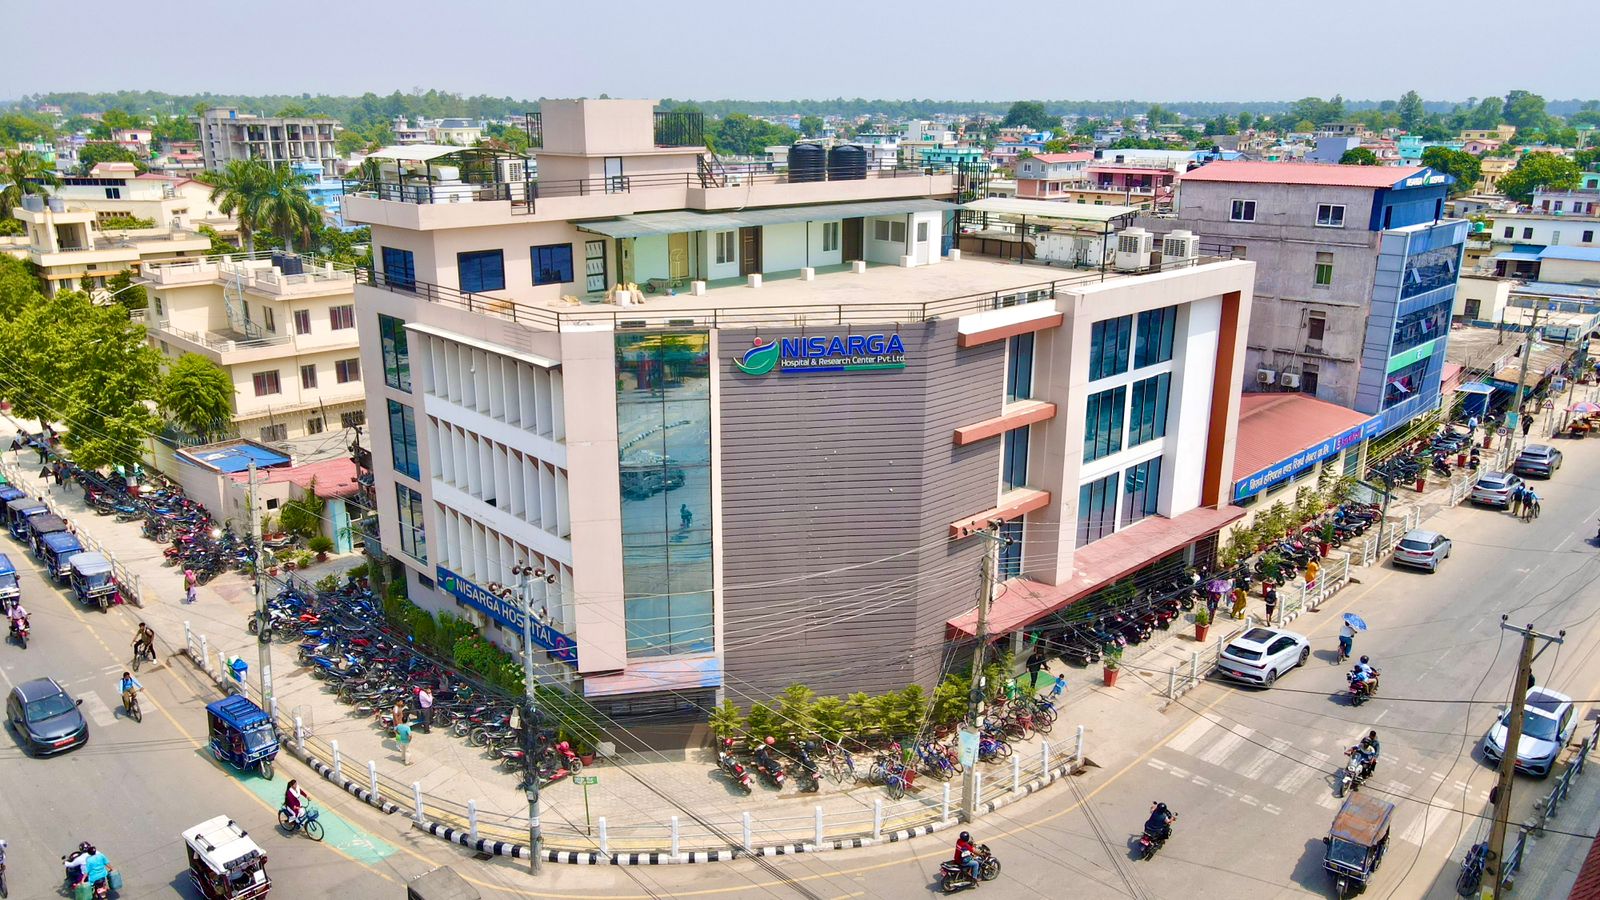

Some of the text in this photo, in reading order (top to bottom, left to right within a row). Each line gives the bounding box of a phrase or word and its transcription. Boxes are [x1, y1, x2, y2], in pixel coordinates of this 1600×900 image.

[781, 334, 905, 358] NISARGA
[781, 358, 810, 368] Hospital
[810, 358, 817, 366] &
[818, 356, 851, 365] Research
[852, 356, 875, 364] Center
[456, 579, 554, 646] NISARGA HOSITAL
